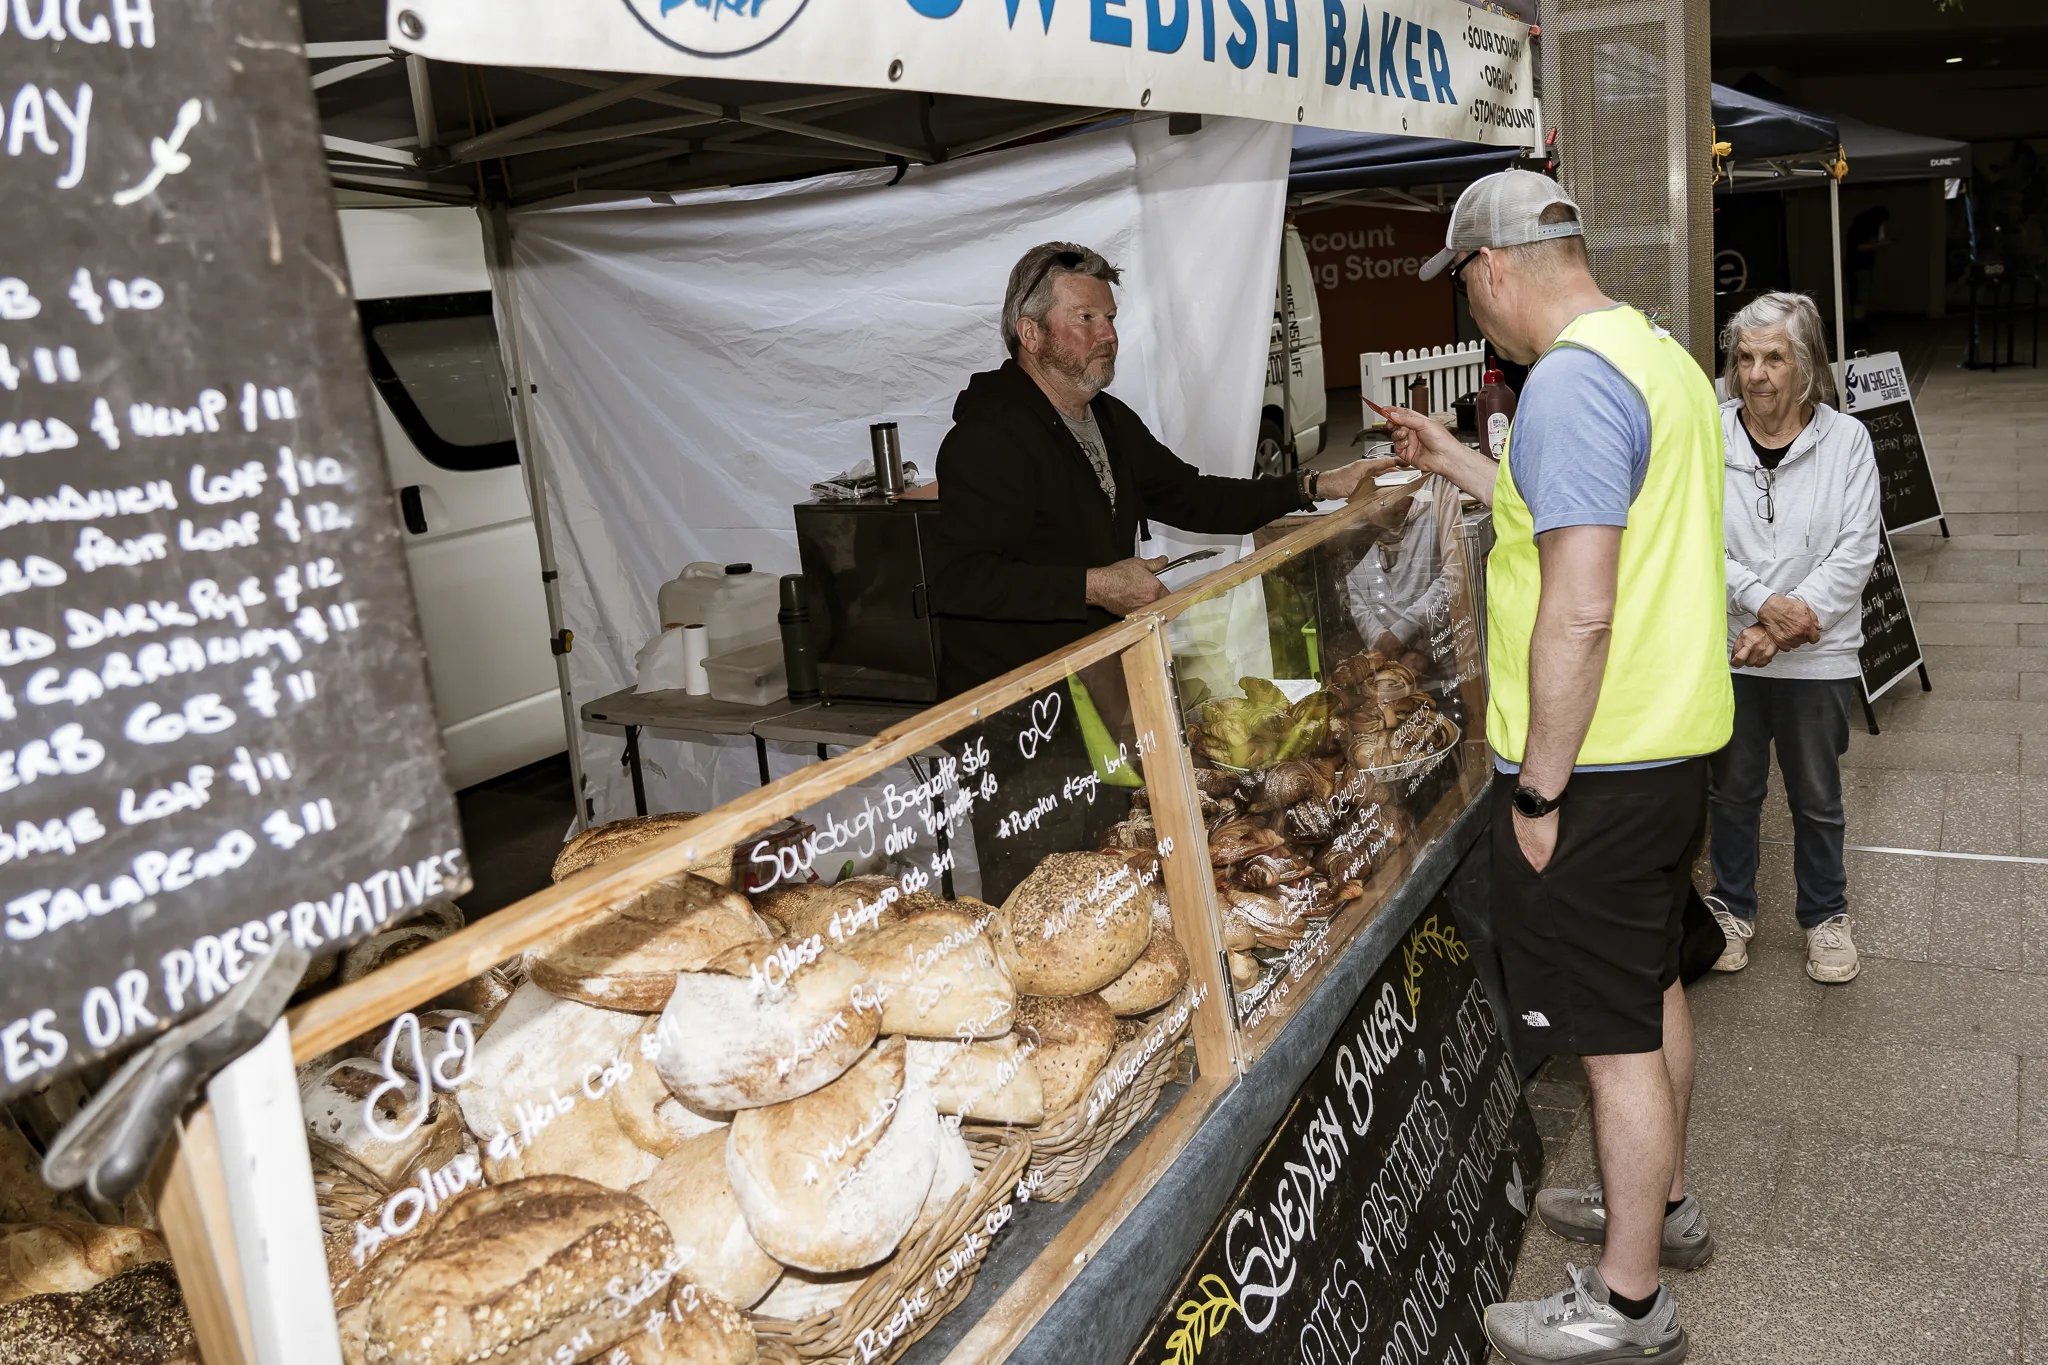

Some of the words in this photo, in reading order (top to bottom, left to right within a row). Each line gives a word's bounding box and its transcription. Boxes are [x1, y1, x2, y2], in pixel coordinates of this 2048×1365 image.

[0, 0, 156, 49] UGH
[1468, 24, 1495, 53] SOUR
[1324, 0, 1458, 106] BAKER
[1484, 64, 1514, 95] ORGANIC
[0, 82, 94, 189] AY
[189, 463, 268, 505] LOAF
[179, 510, 261, 552] LOAF
[274, 497, 353, 543] $12
[64, 600, 199, 650] DARK
[274, 556, 344, 613] $12
[961, 736, 991, 775] $6
[119, 764, 215, 826] LOAF
[1008, 793, 1059, 836] Pumpkin
[1134, 729, 1157, 760] $11
[1328, 769, 1367, 817] DANISH
[1157, 835, 1174, 859] $10
[1241, 967, 1277, 1014] CHEESE
[1294, 958, 1316, 983] SCROLL
[81, 968, 159, 1051] OR
[1191, 981, 1209, 1010] $11
[1245, 999, 1271, 1030] TWIST
[1225, 1096, 1350, 1334] SWEDISH
[1334, 980, 1418, 1137] BAKER
[1015, 1169, 1043, 1203] $10
